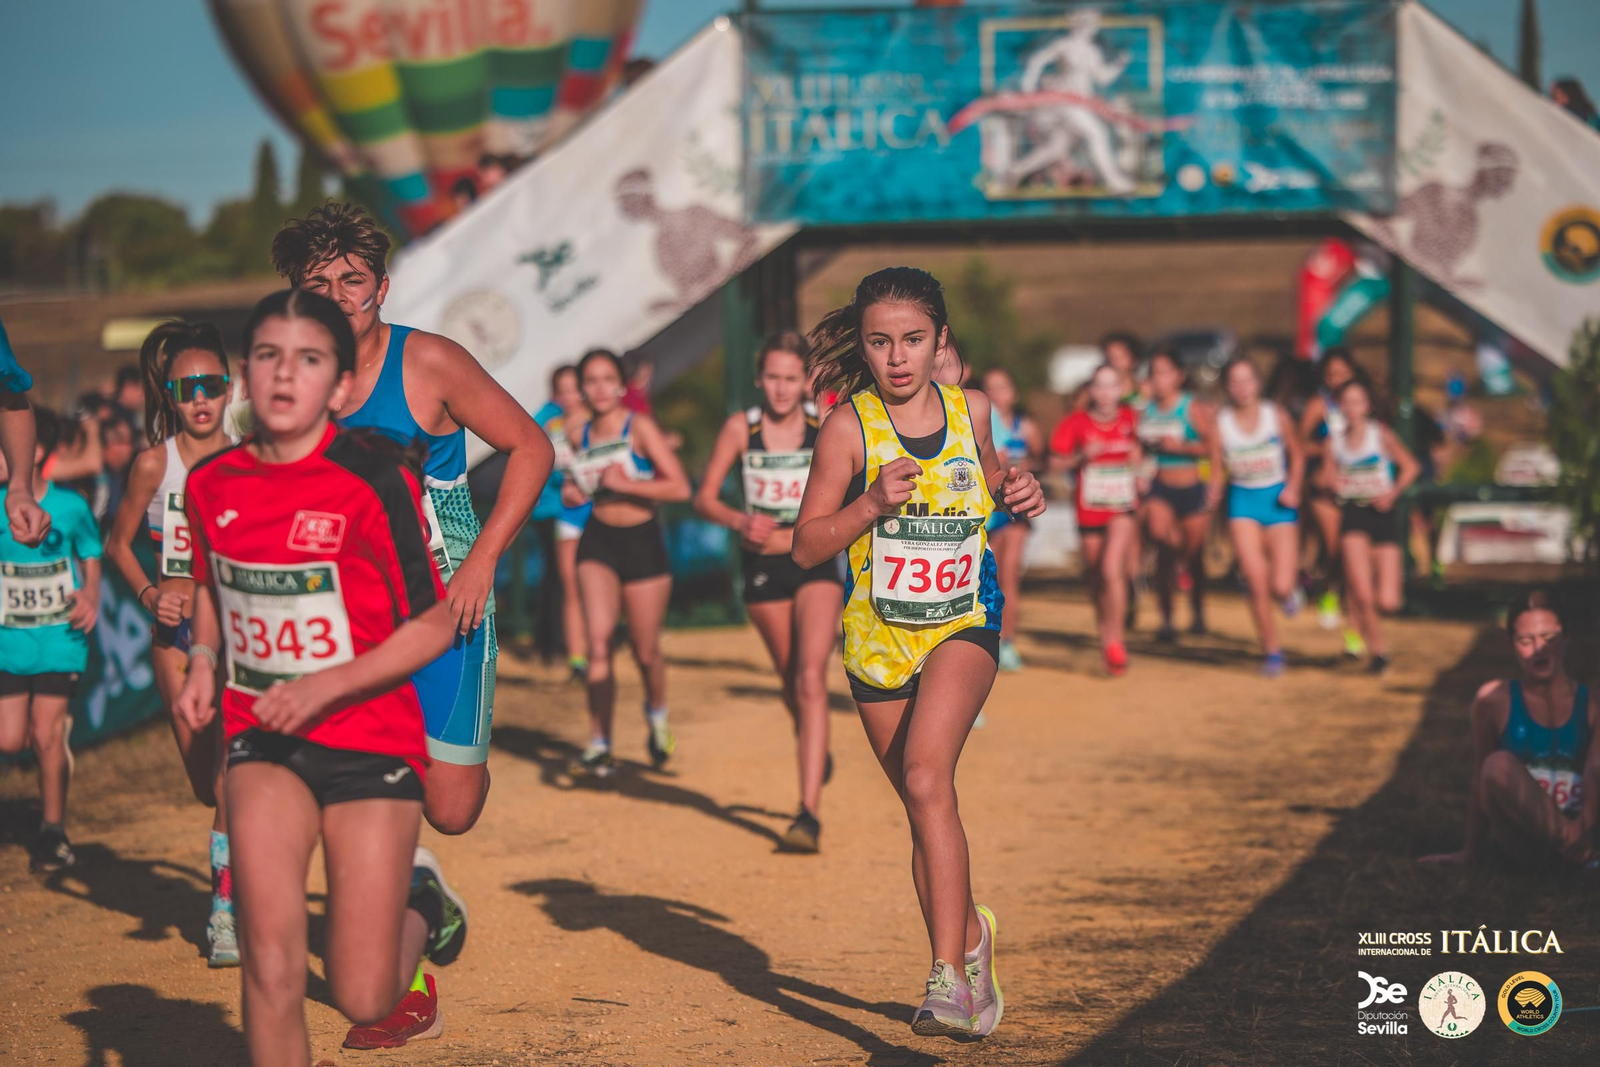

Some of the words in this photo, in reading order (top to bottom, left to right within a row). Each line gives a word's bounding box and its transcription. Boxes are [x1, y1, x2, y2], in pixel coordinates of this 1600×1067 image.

[907, 520, 964, 534] ITÁLICA
[884, 553, 972, 594] 7362
[8, 585, 67, 610] 5851
[229, 610, 338, 660] 5343
